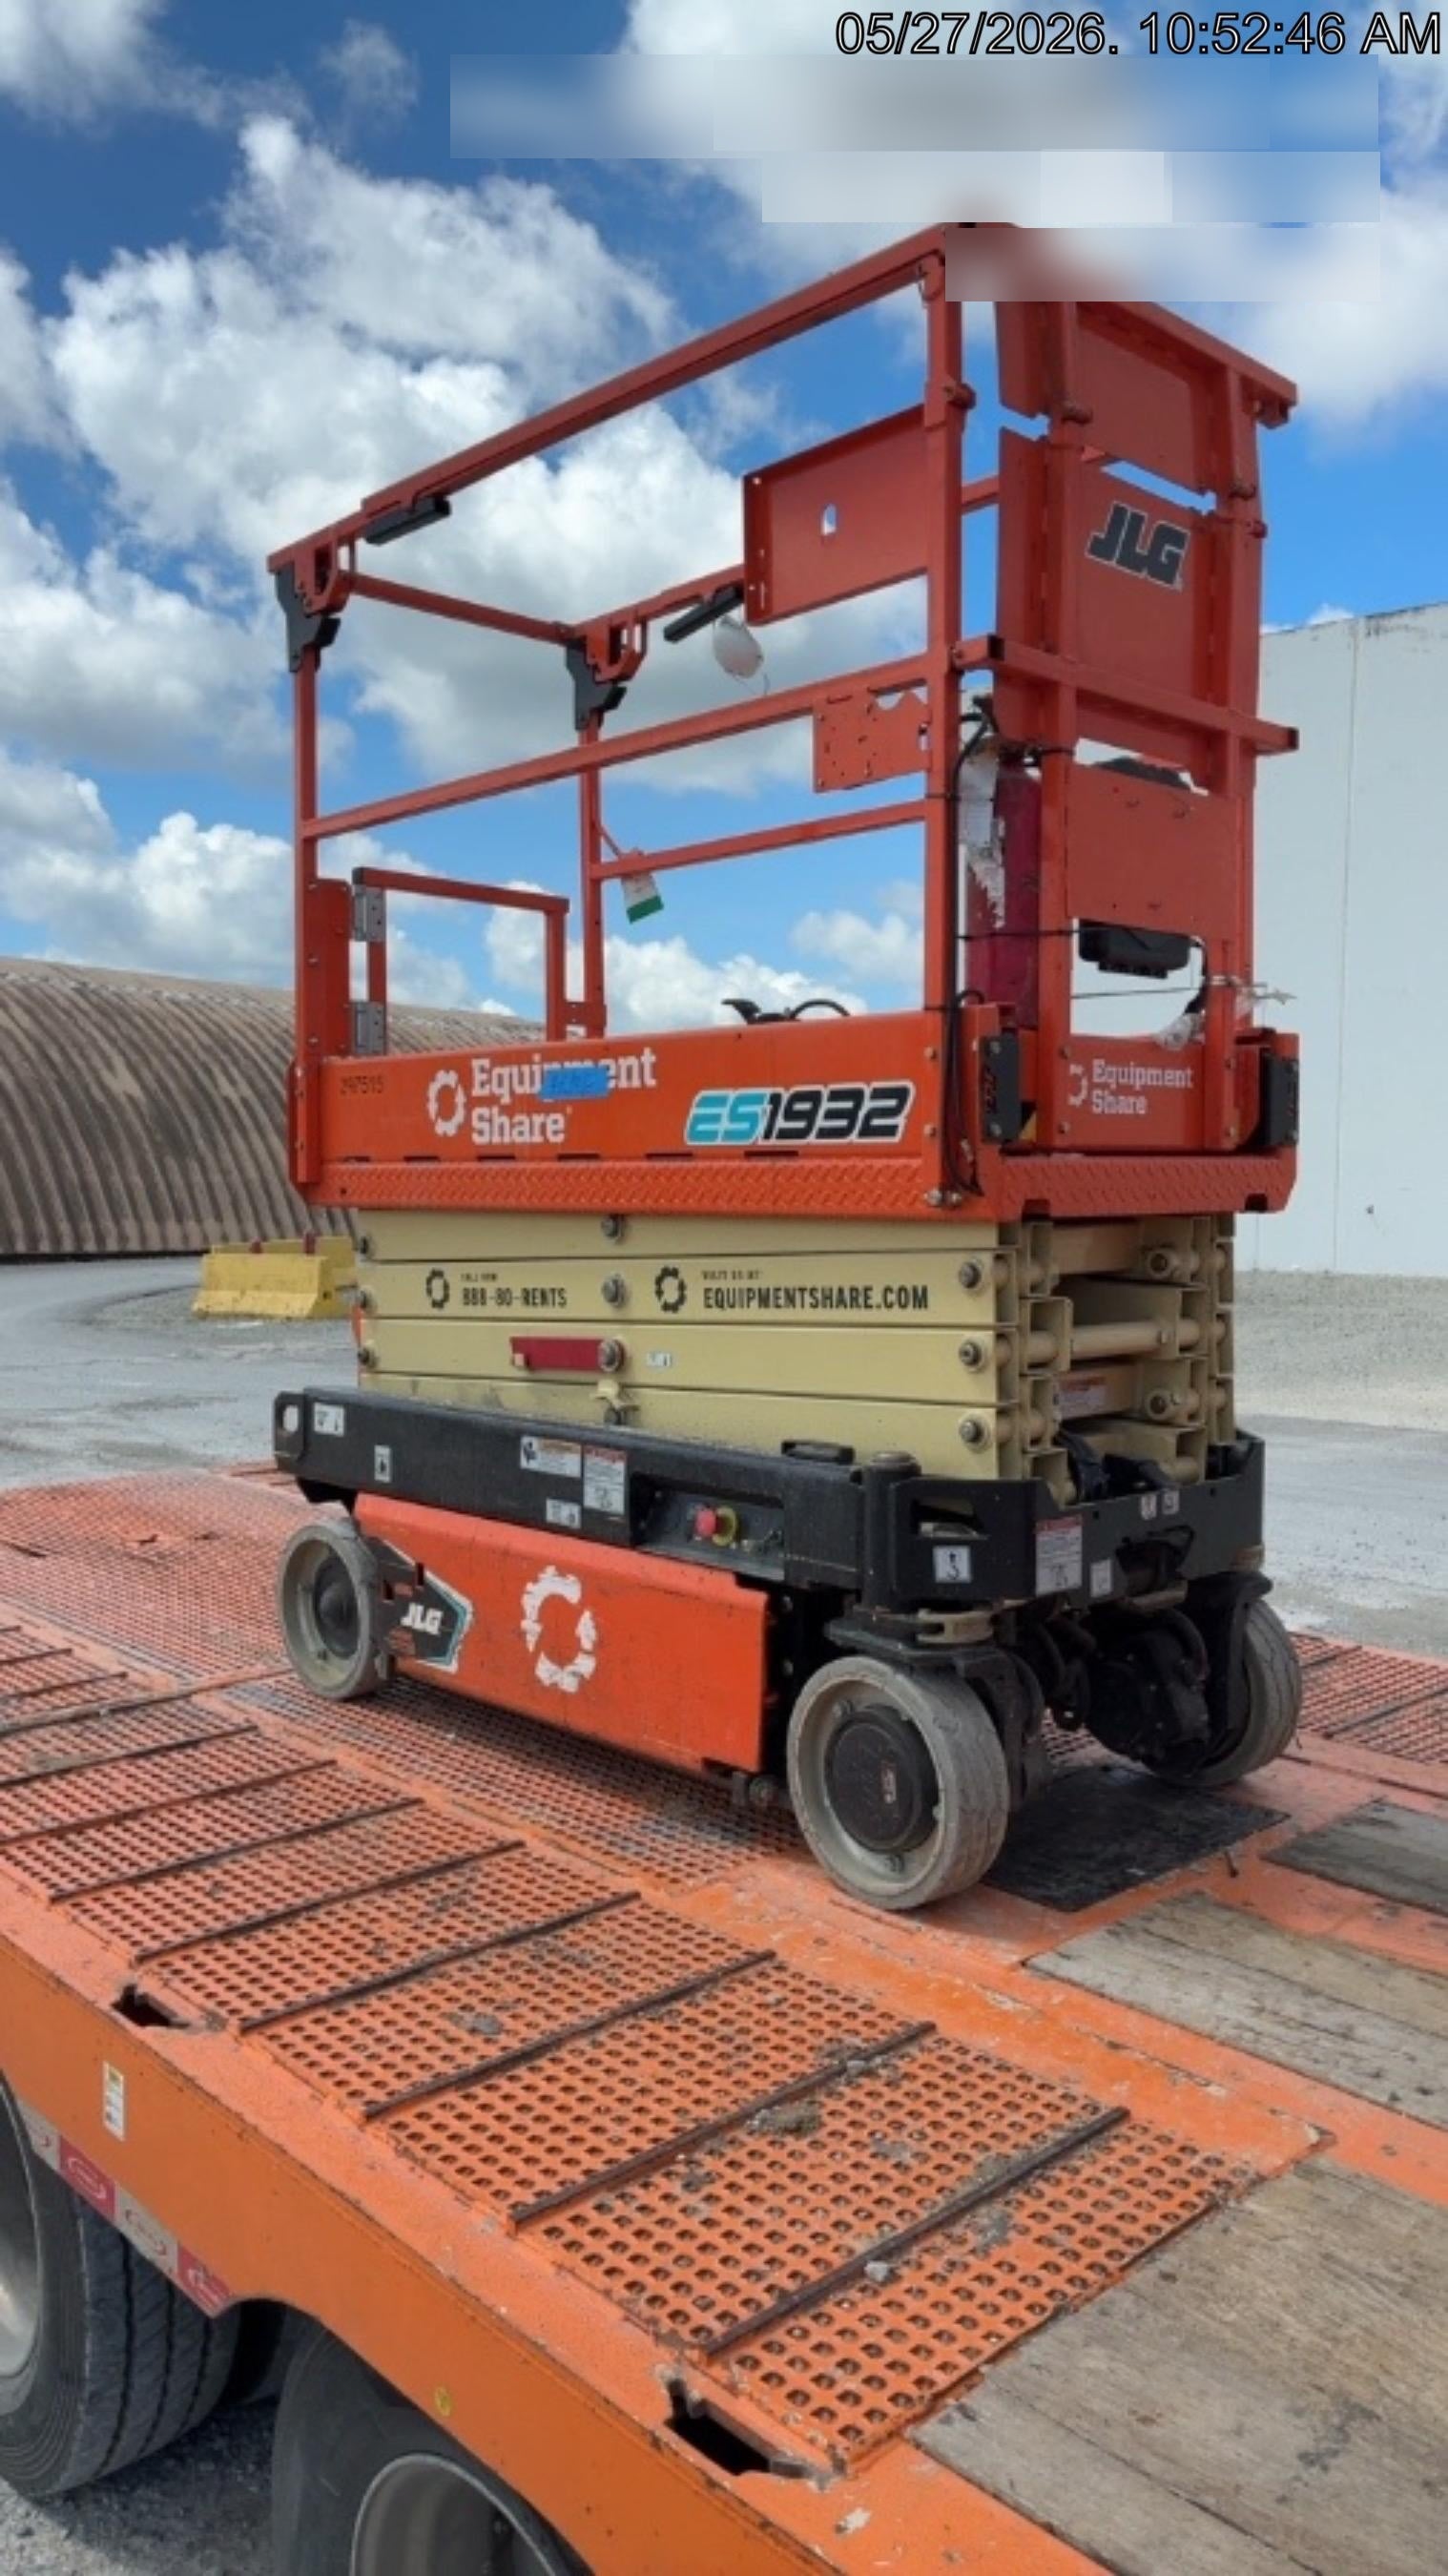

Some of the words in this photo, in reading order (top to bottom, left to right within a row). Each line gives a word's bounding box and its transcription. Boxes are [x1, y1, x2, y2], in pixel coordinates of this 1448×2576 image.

[1085, 500, 1190, 592] JLG
[471, 1047, 657, 1105] Equient
[1092, 1058, 1194, 1091] Equipment
[685, 1080, 915, 1145] ES1932
[1092, 1089, 1148, 1114] Share
[471, 1106, 566, 1144] Share
[703, 1285, 928, 1311] EQUIPMENTSHARE.COM
[400, 1602, 443, 1635] JLG
